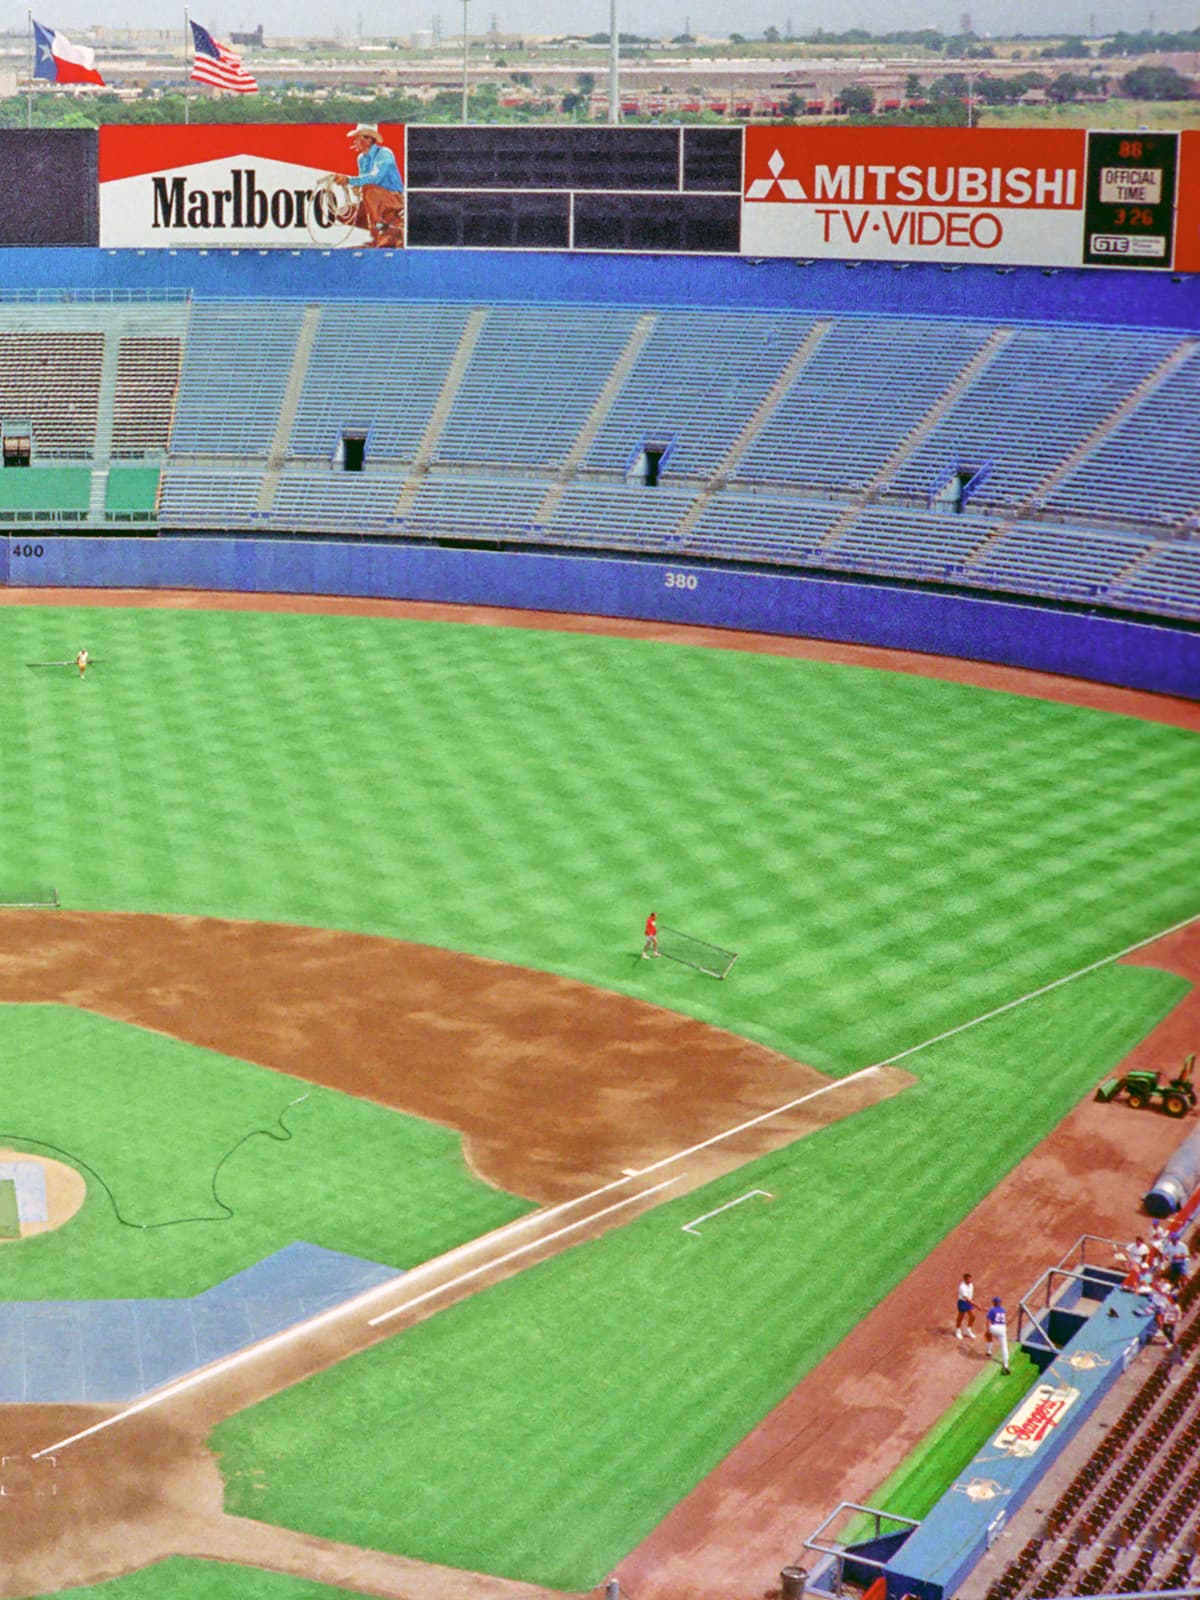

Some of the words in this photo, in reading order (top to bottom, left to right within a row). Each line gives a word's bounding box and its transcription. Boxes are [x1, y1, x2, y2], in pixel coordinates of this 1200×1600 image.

[814, 164, 1076, 204] MITSUBISHI
[1105, 170, 1157, 185] OFFICIAL
[151, 169, 339, 229] Marlboro
[1116, 186, 1147, 201] TIME
[1096, 238, 1129, 252] GTE
[12, 544, 44, 558] 400
[664, 572, 698, 590] 380
